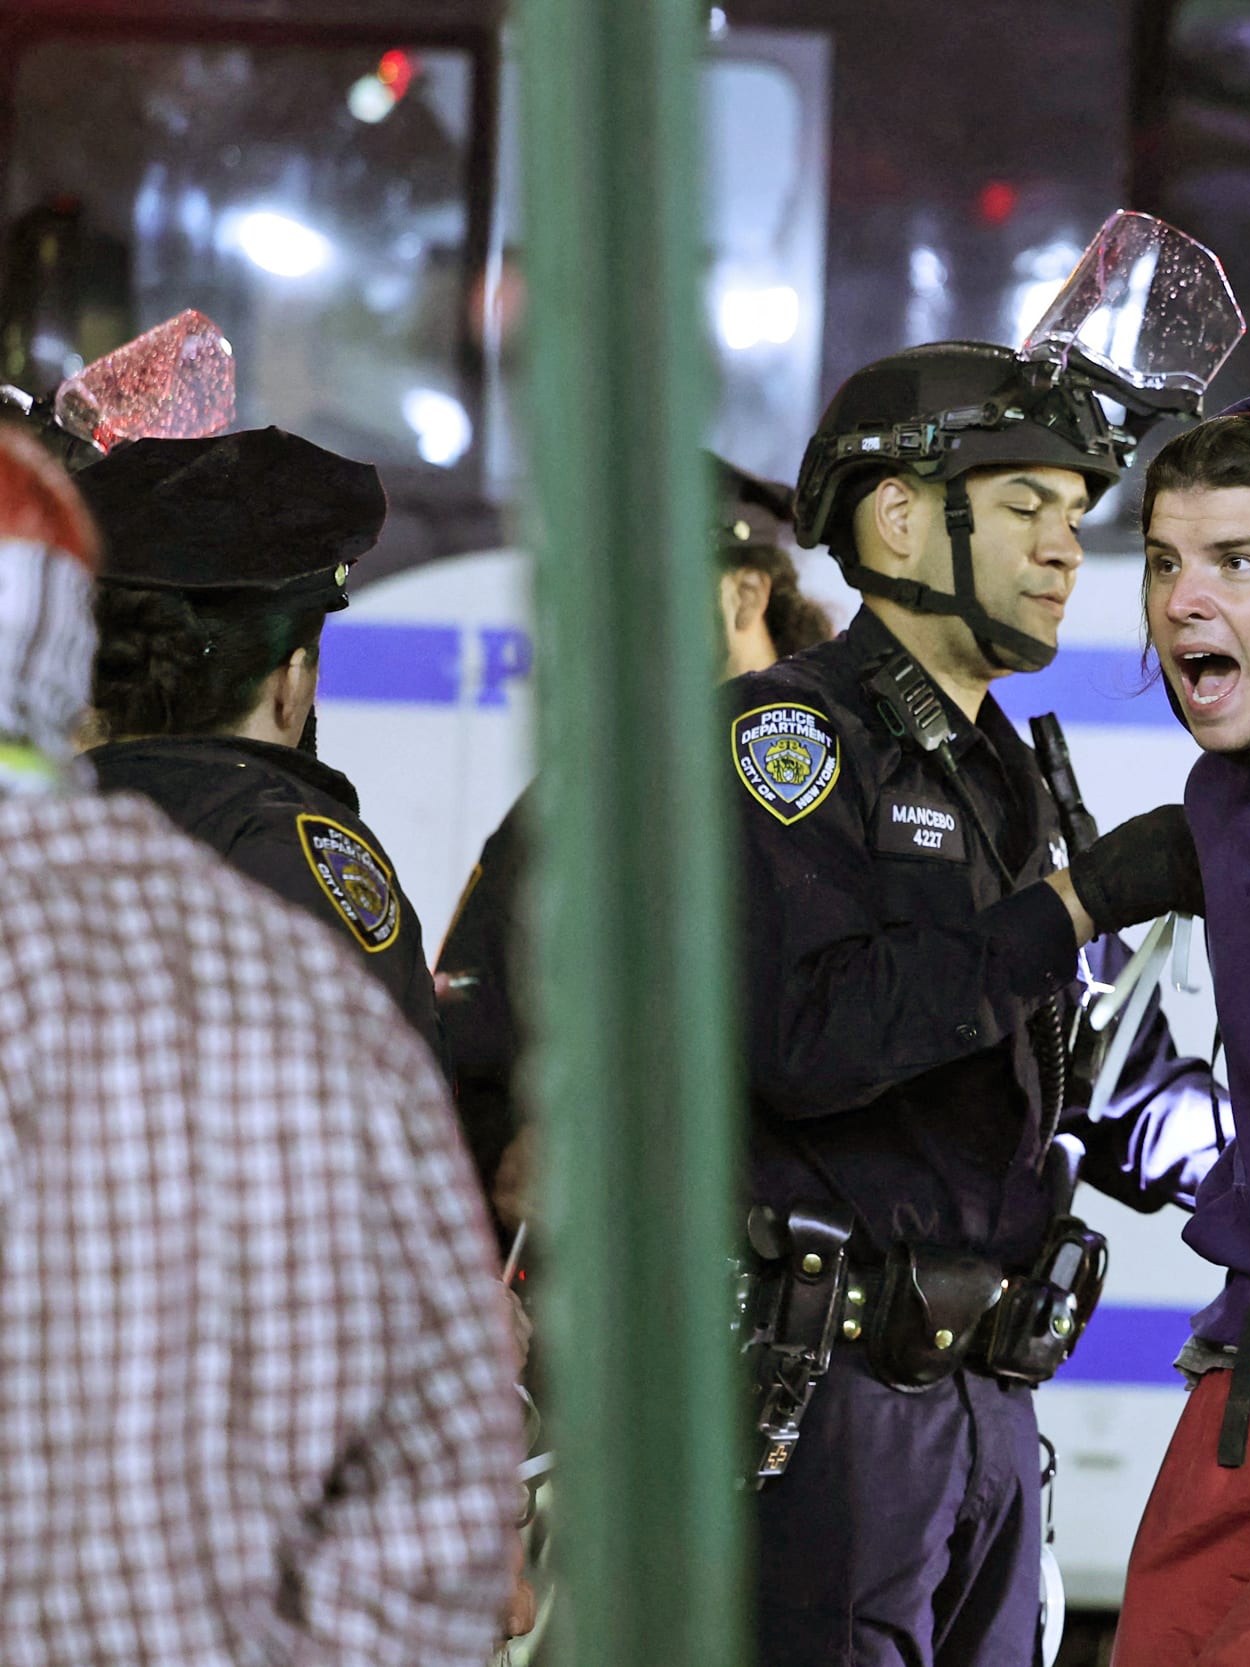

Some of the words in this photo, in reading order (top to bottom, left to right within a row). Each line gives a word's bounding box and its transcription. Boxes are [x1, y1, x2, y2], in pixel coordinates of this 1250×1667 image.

[760, 709, 816, 728] POLICE
[741, 722, 833, 748] DEPARTMENT
[740, 755, 762, 784] CITY
[757, 784, 777, 802] OF
[795, 785, 820, 810] NEW
[815, 755, 837, 788] YORK
[892, 804, 955, 831] MANCEBO
[913, 829, 943, 849] 4227
